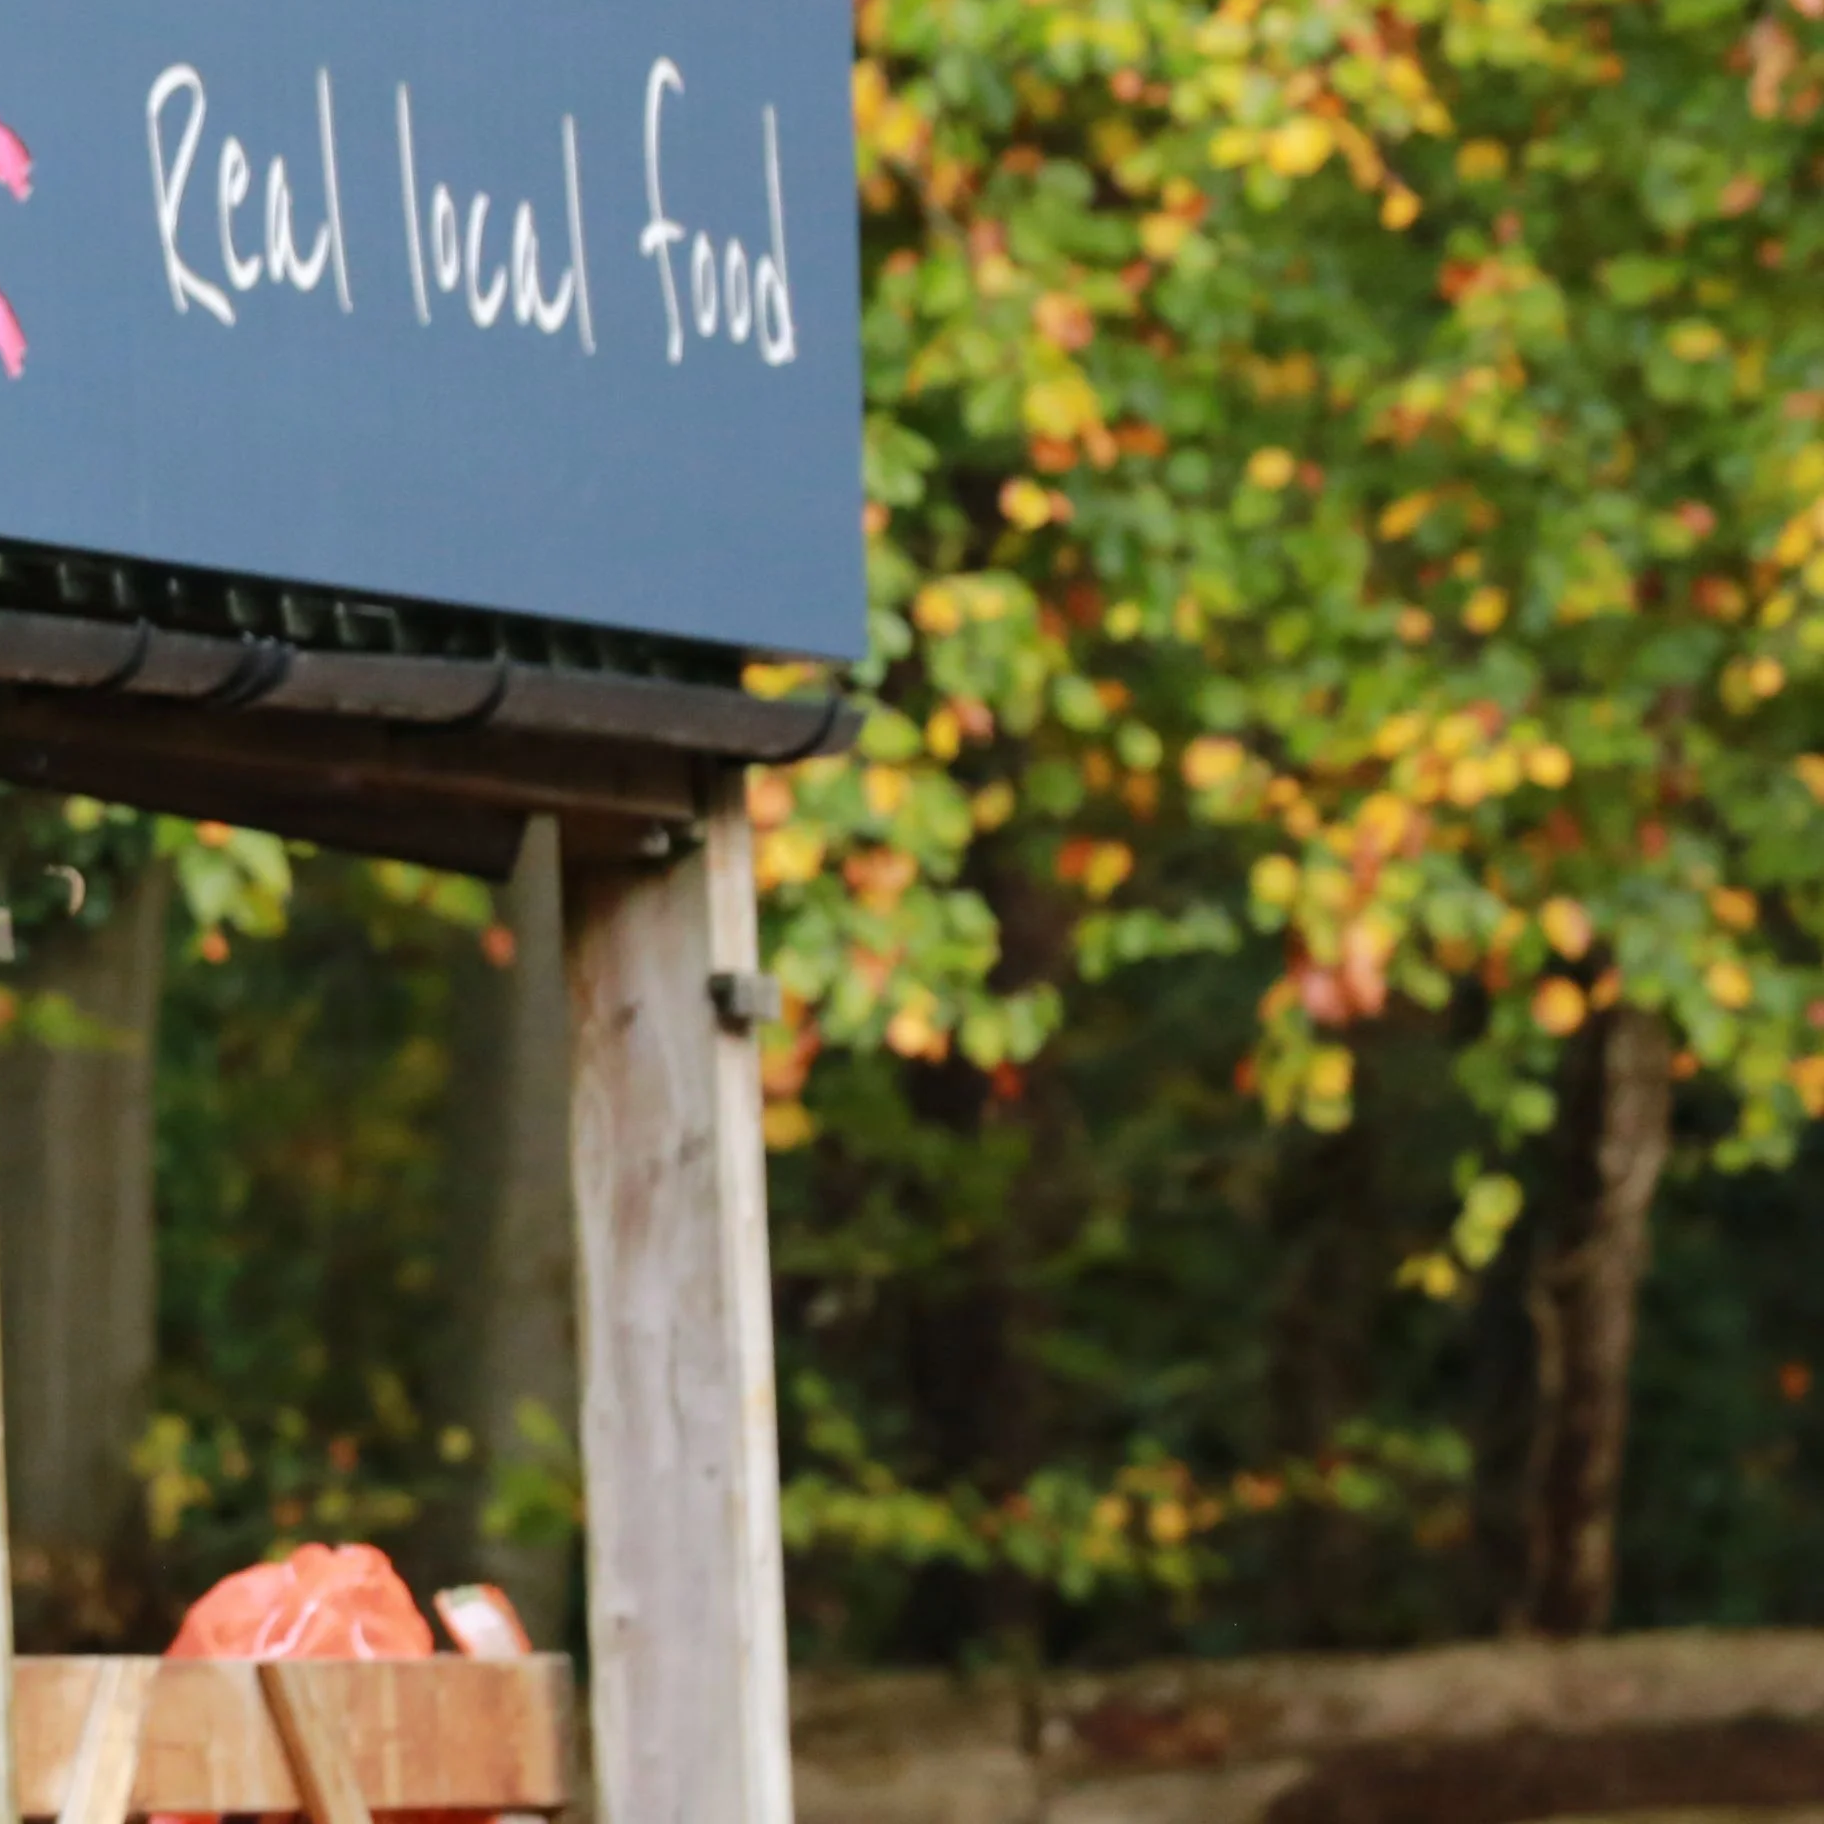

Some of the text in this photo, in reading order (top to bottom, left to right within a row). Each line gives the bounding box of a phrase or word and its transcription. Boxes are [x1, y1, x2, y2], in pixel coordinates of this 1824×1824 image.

[145, 55, 799, 368] Real local food
